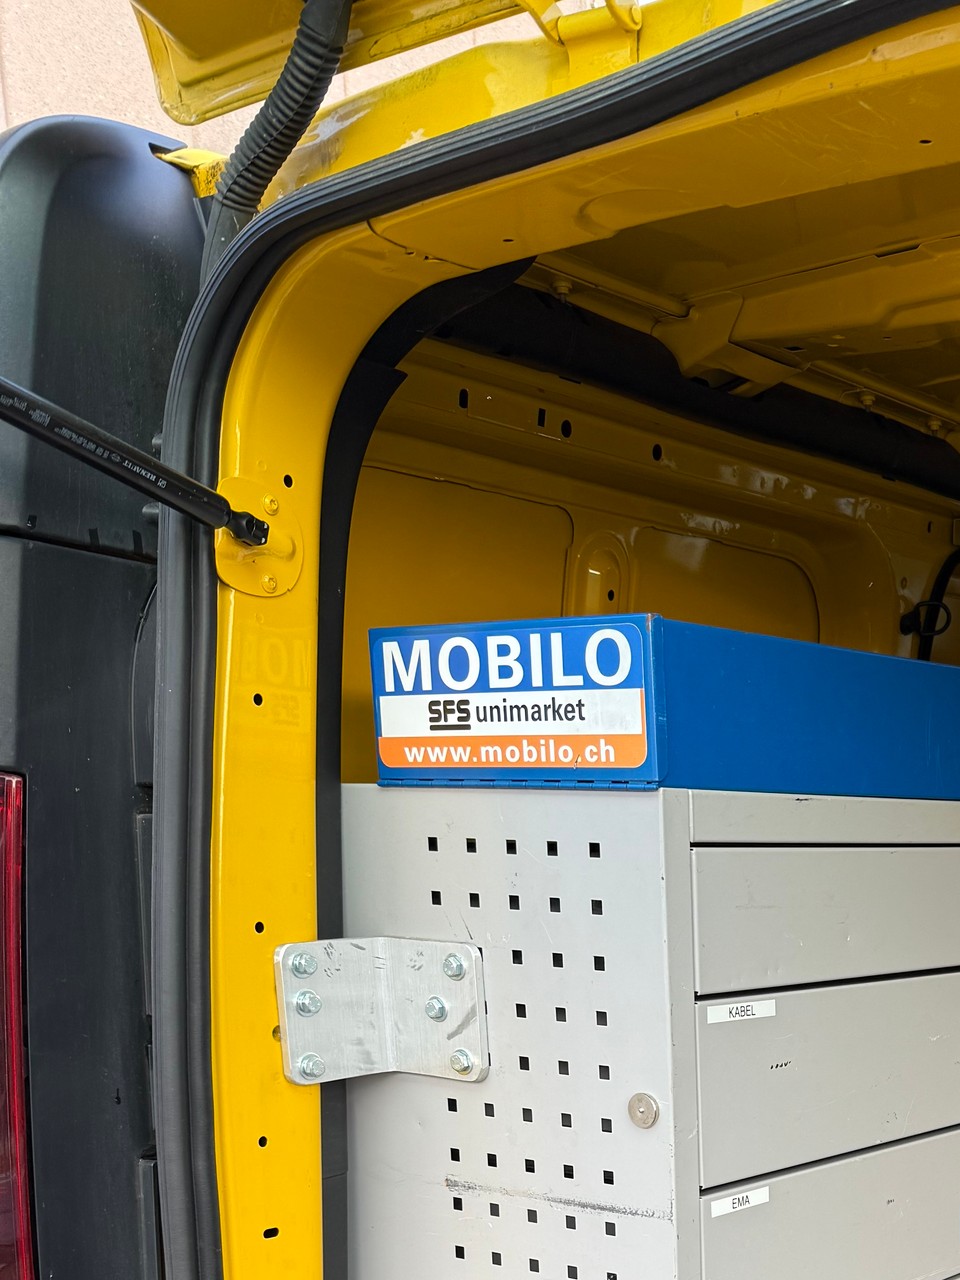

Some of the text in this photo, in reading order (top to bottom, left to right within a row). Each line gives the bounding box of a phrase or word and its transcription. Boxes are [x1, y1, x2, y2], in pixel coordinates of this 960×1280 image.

[122, 460, 157, 481] RENAULT
[382, 628, 632, 693] MOBILO
[428, 697, 586, 724] SFS unimarket
[404, 738, 616, 764] www.mobilo.ch
[728, 1004, 756, 1018] KABEL
[731, 1195, 751, 1210] EMA
